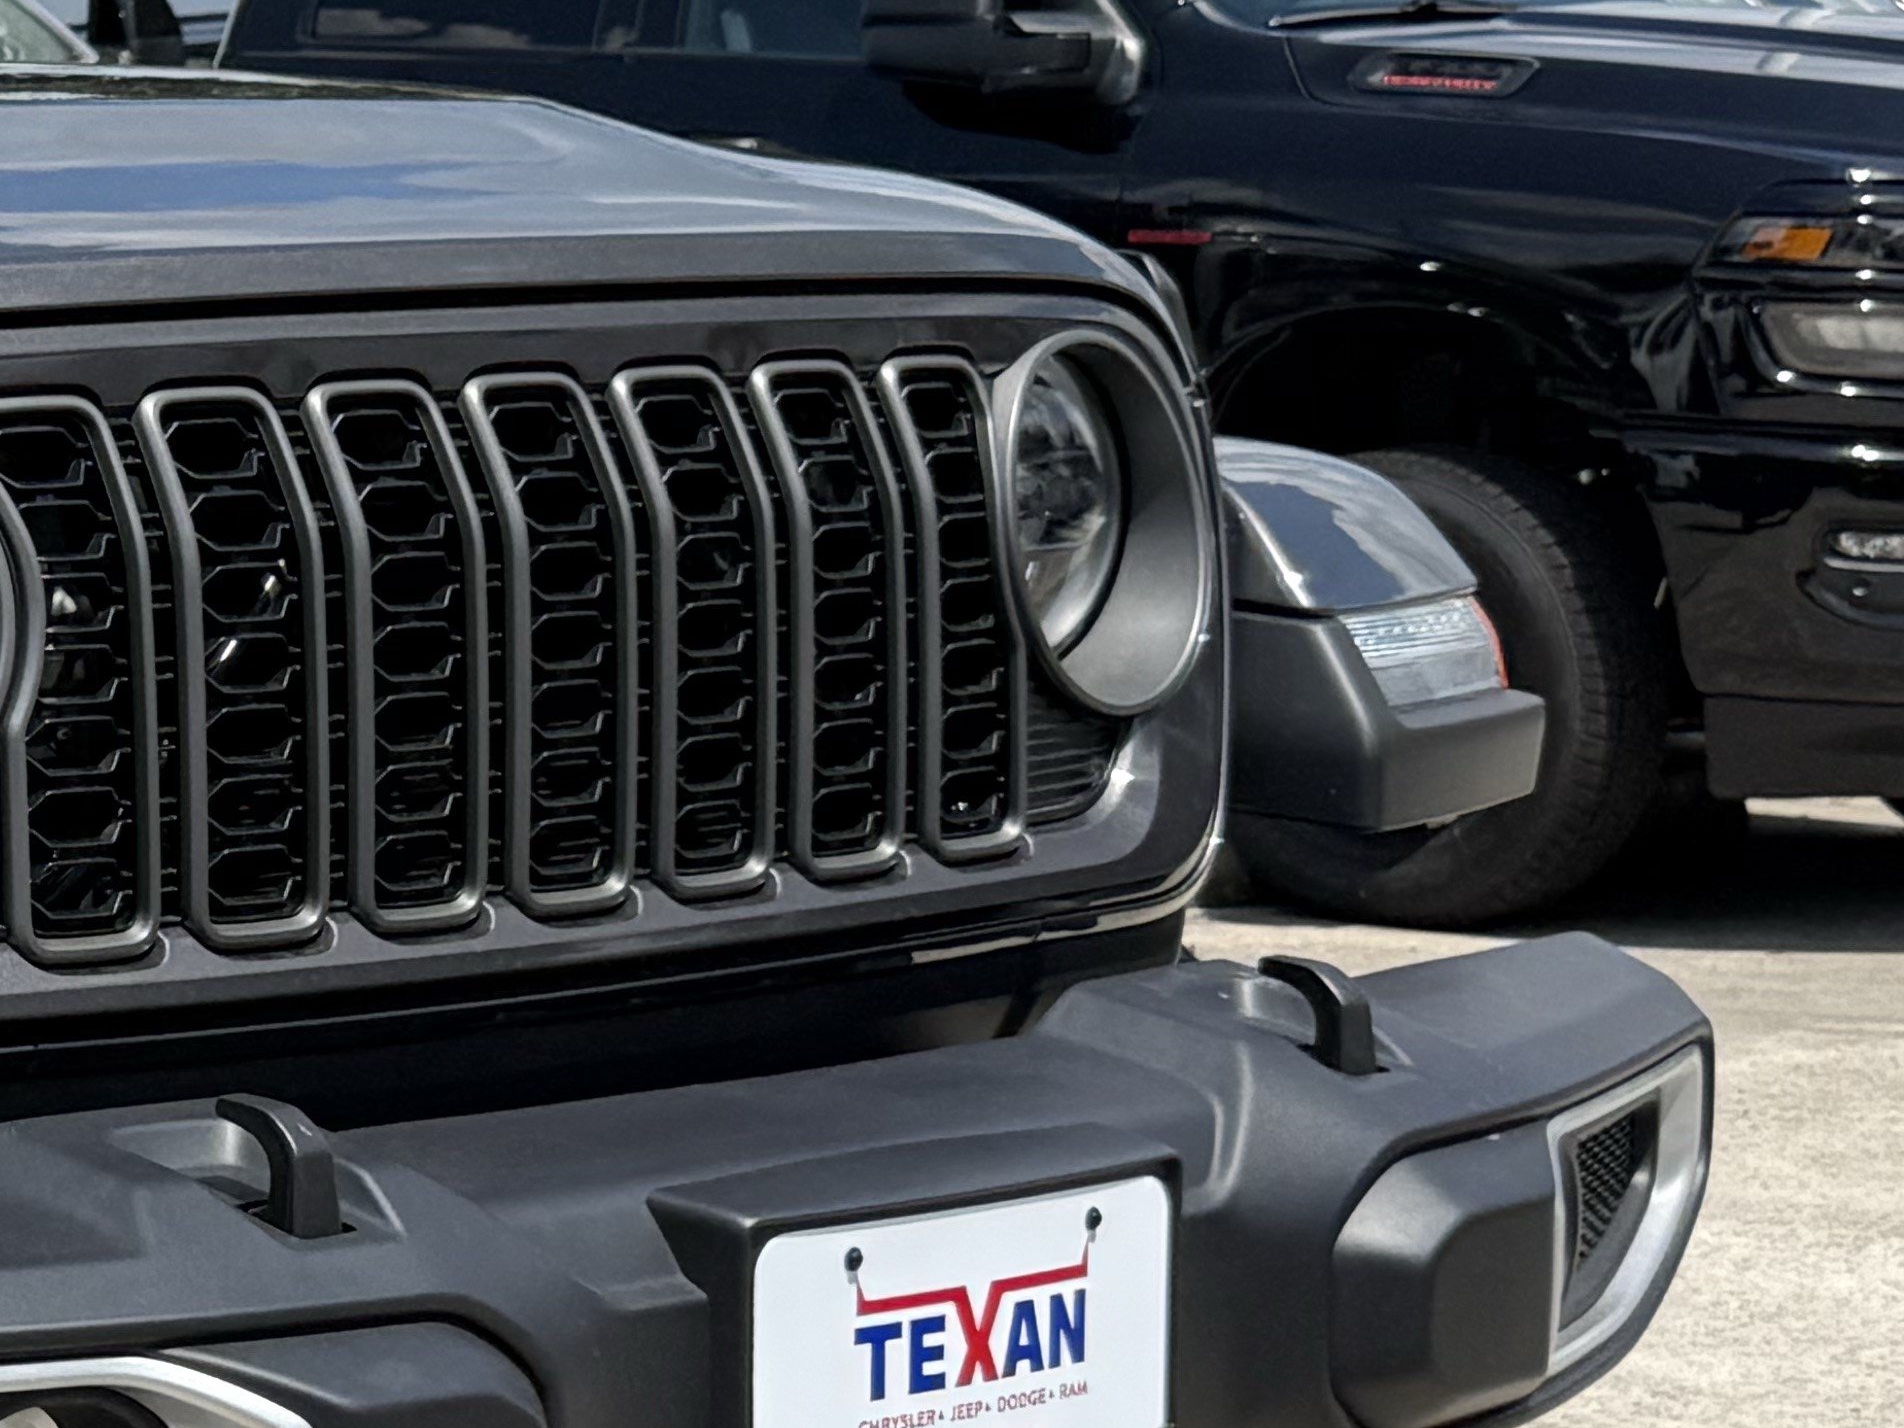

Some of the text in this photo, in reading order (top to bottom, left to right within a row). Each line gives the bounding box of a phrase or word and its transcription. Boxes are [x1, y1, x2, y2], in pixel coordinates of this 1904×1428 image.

[852, 1272, 1088, 1402] TEXAN
[950, 1401, 983, 1423] JEEP
[997, 1389, 1046, 1413] DODGE
[1059, 1380, 1088, 1399] RAM
